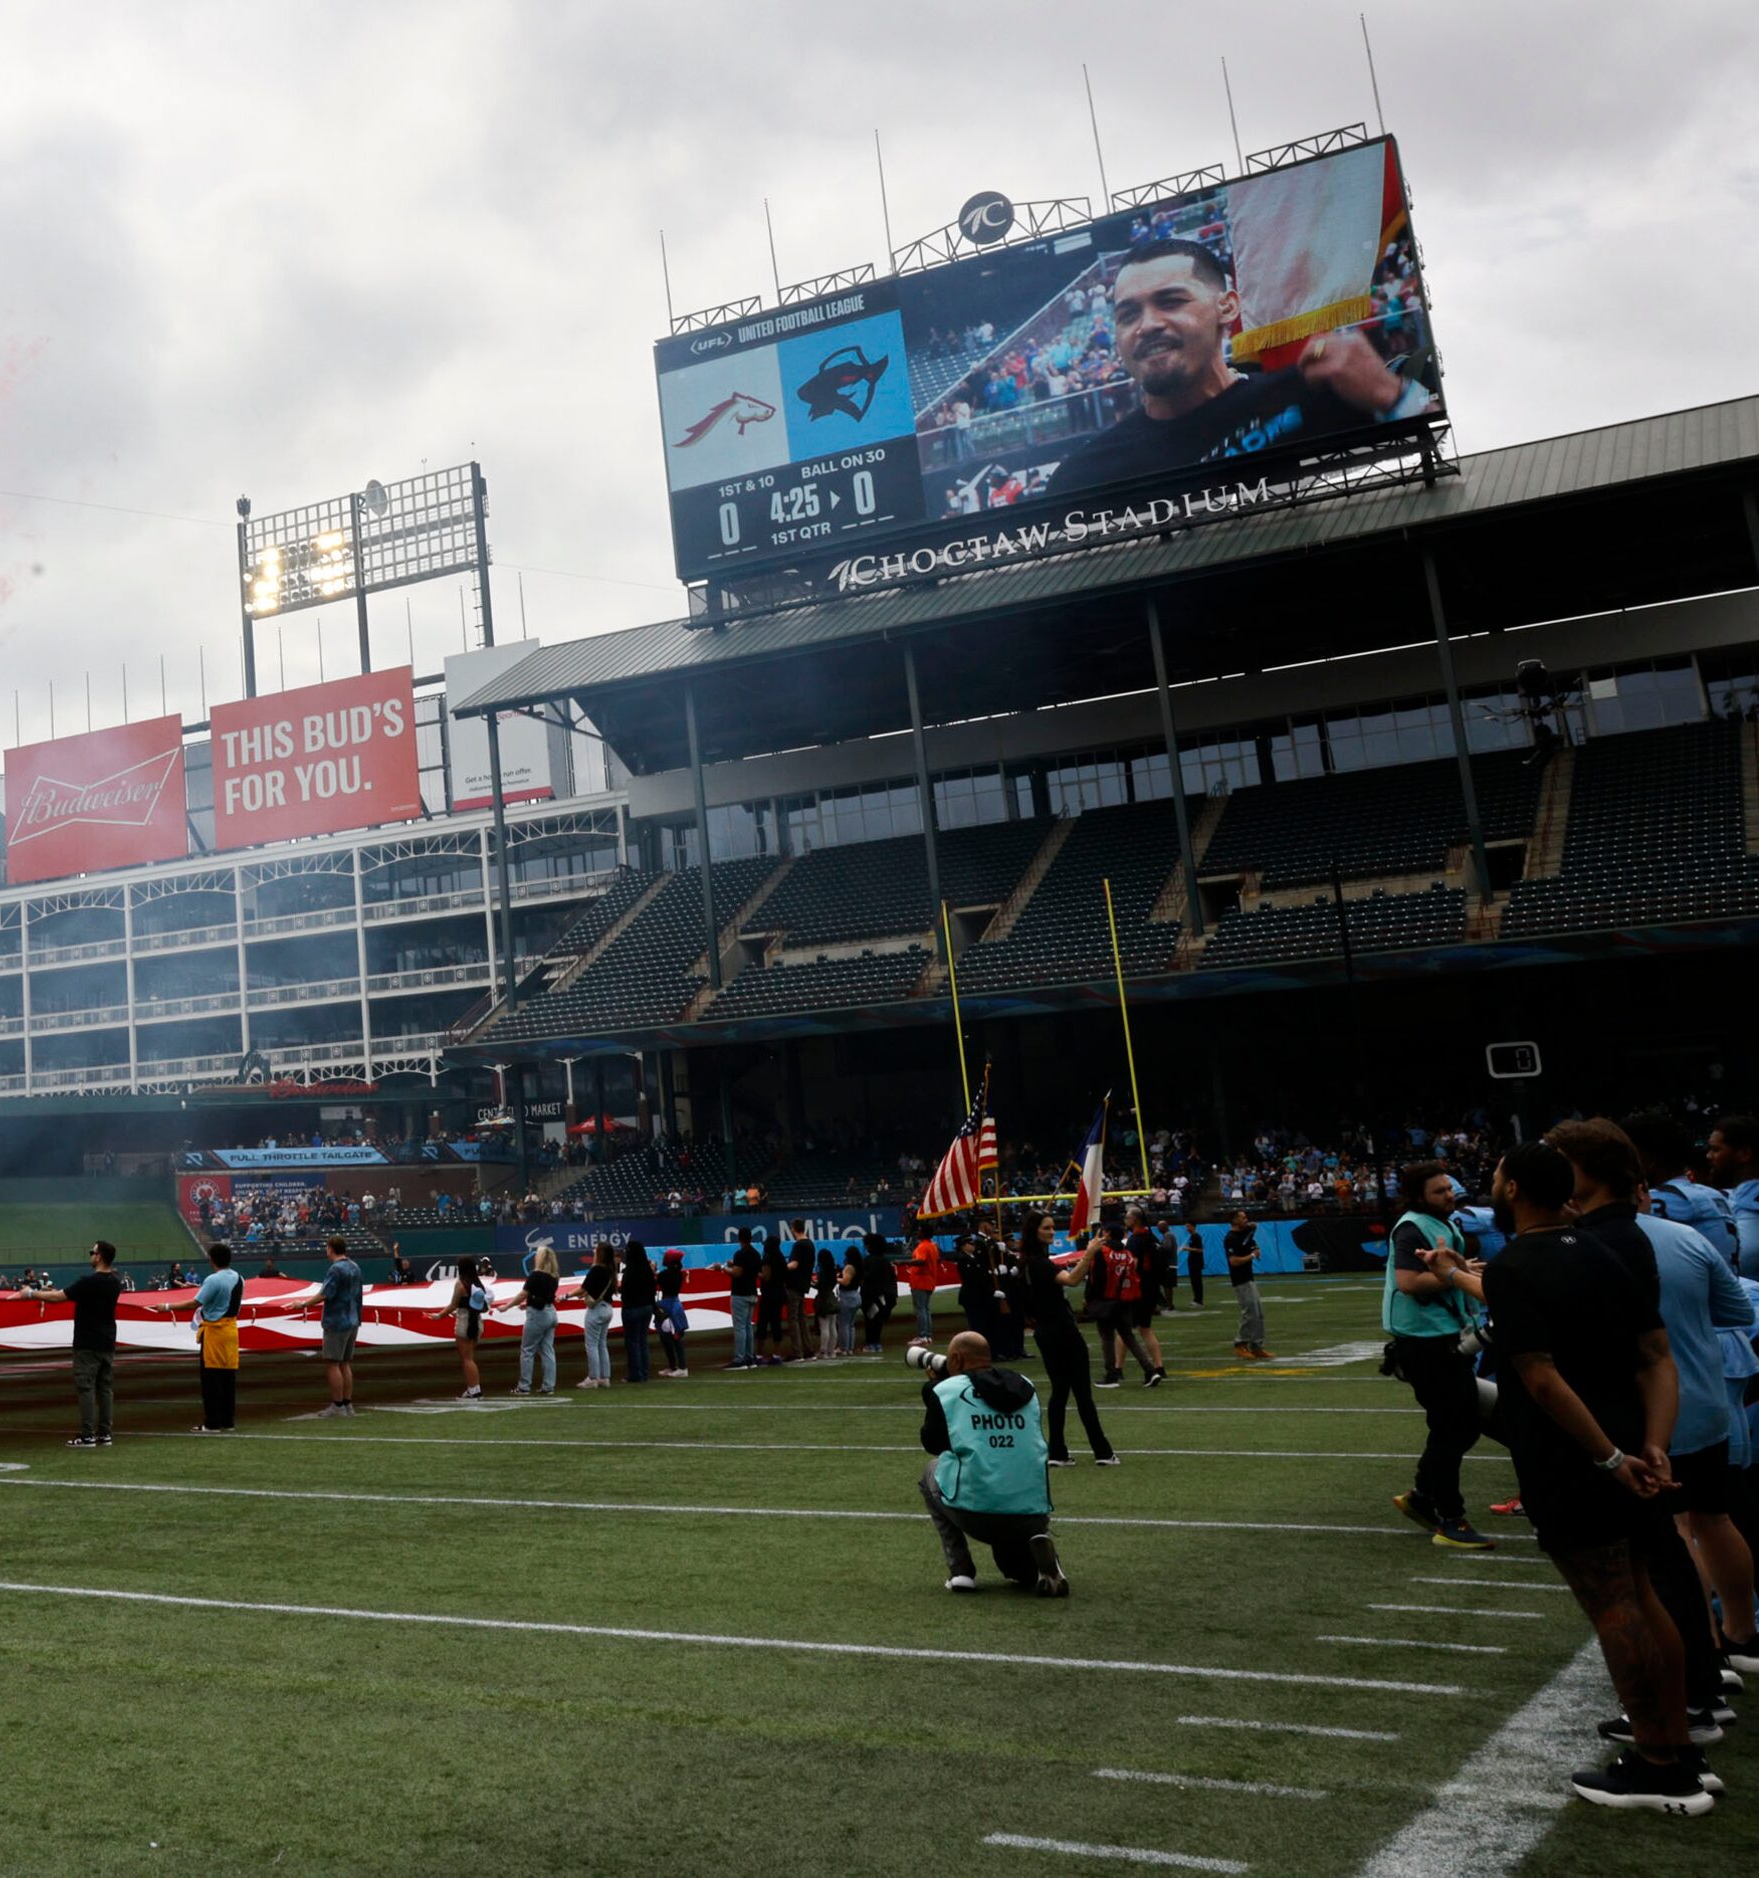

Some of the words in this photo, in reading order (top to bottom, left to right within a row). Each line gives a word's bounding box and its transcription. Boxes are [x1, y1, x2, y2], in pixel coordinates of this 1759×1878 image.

[696, 335, 726, 351] UFL
[738, 321, 774, 343] UNITED
[776, 309, 826, 333] FOOTBALL
[826, 293, 865, 320] LEAGUE
[801, 461, 838, 479] BALL
[841, 454, 863, 469] ON
[865, 448, 886, 462] 30
[719, 482, 742, 498] 1ST
[745, 479, 756, 492] &
[758, 475, 775, 489] 10
[853, 470, 876, 516] 0
[770, 483, 820, 524] 4:25
[719, 502, 740, 546] 0
[771, 529, 796, 545] 1ST
[800, 522, 832, 540] QTR
[850, 522, 1051, 587] CHOCTAW
[1063, 476, 1271, 542] STADIUM
[221, 721, 294, 769] THIS
[303, 698, 405, 753] BUD'S
[225, 769, 287, 815] FOR
[294, 755, 373, 801] YOU.
[21, 780, 162, 825] Budweiser
[1515, 1048, 1531, 1070] 0
[530, 1102, 562, 1117] MARKET
[230, 1154, 258, 1162] FULL
[263, 1152, 318, 1161] THROTTLE
[321, 1151, 372, 1160] TAILGATE
[567, 1231, 632, 1249] ENERGY
[971, 1414, 1025, 1430] PHOTO
[989, 1435, 1015, 1448] 022
